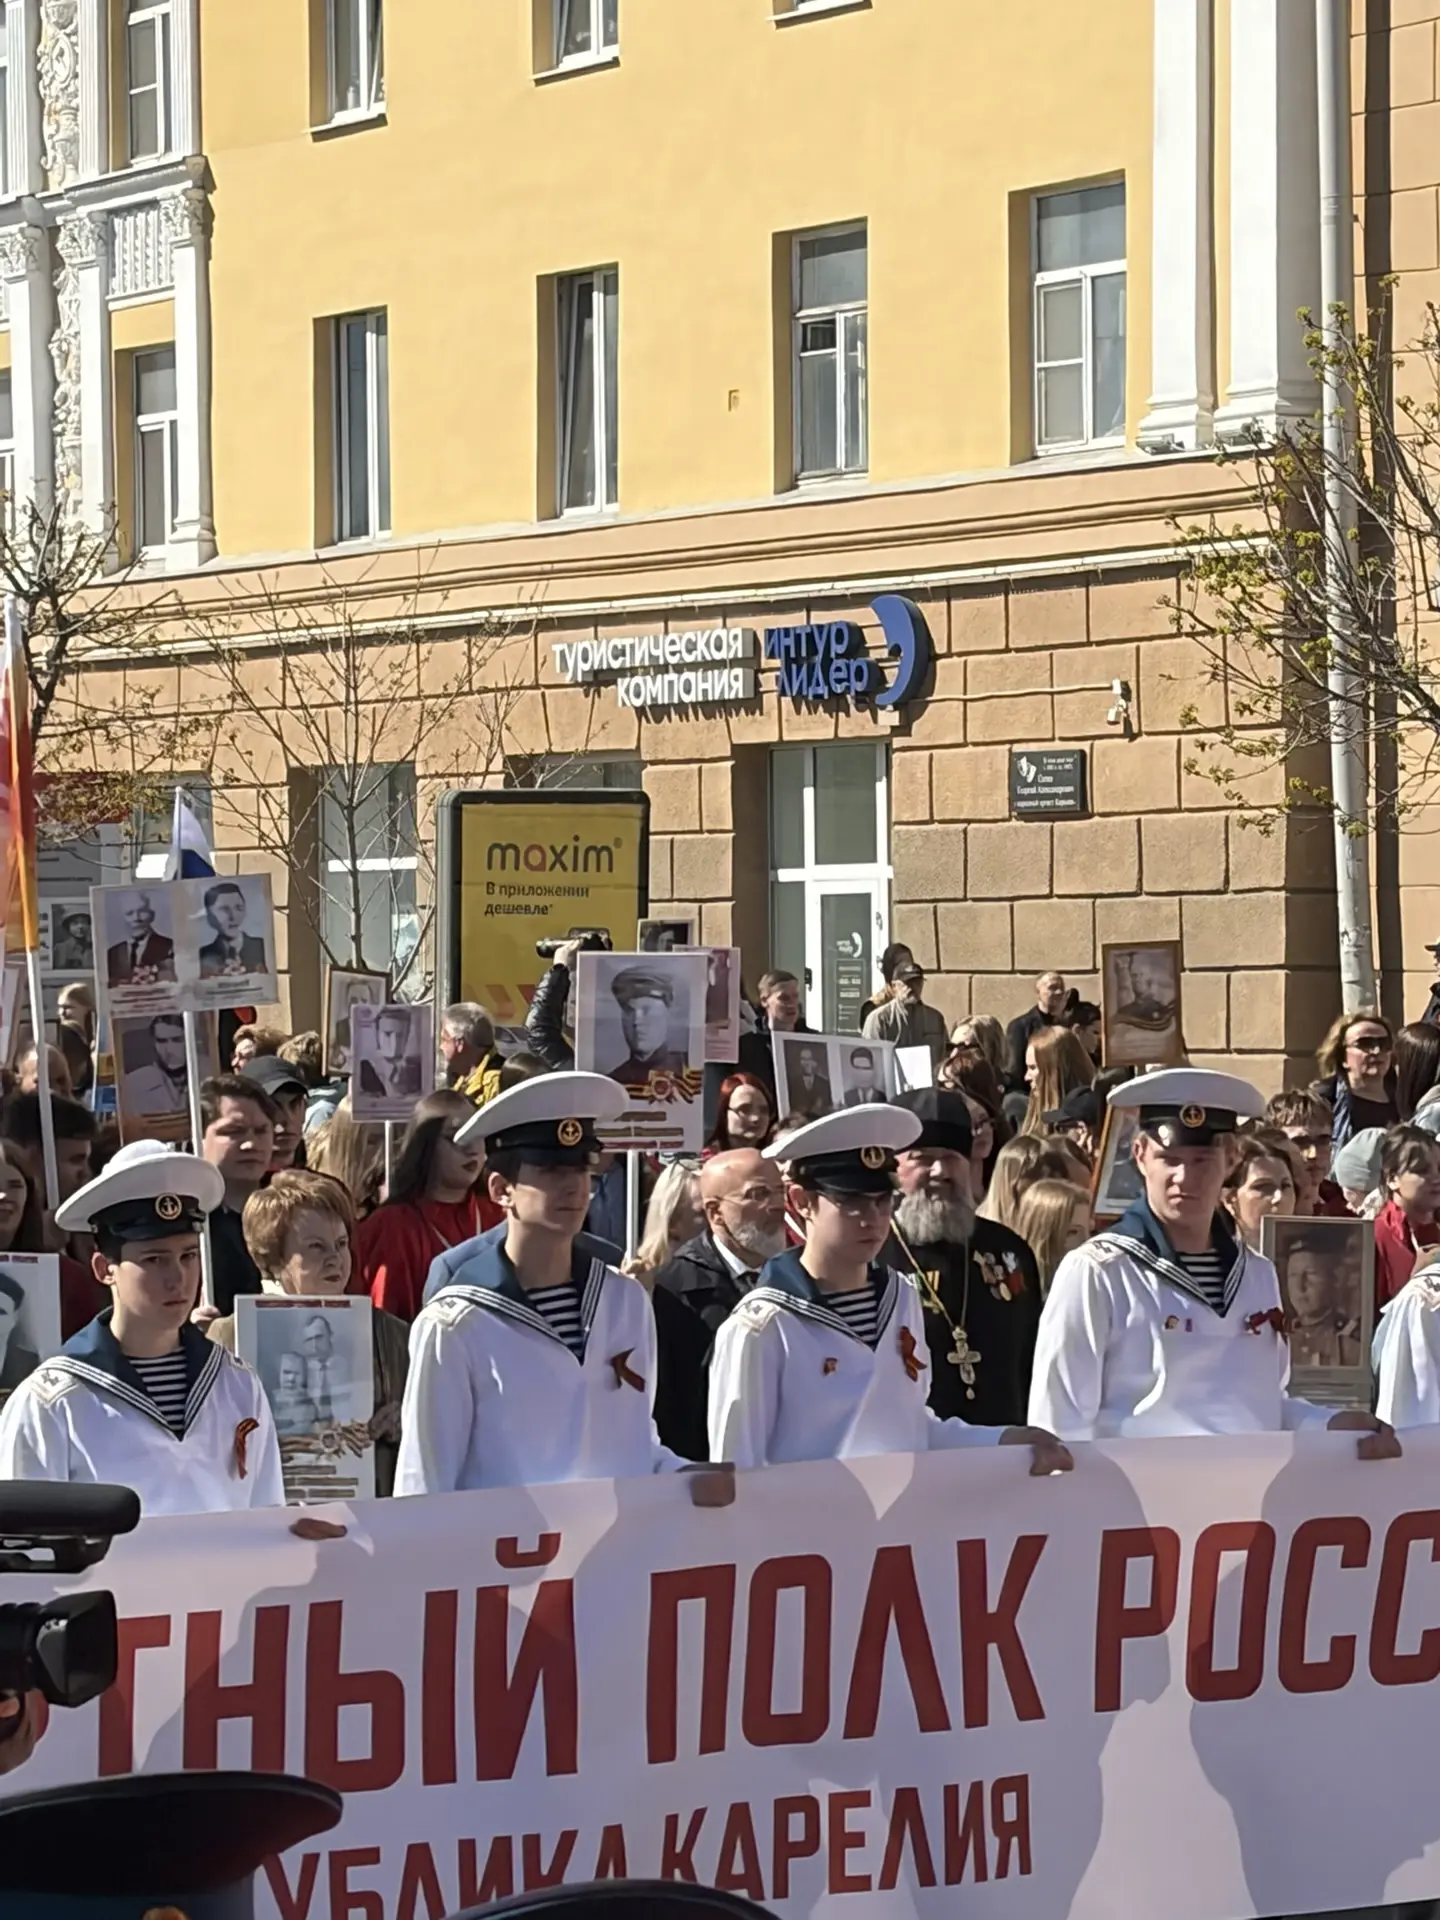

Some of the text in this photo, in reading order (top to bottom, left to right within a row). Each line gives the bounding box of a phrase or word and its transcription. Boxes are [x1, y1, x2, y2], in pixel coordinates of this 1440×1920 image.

[551, 627, 743, 682] туристическая
[764, 620, 849, 663] интур
[616, 667, 744, 708] компания
[777, 657, 869, 700] лидер
[487, 834, 614, 873] maxim
[486, 881, 590, 899] В приложении
[35, 1509, 1440, 1793] ТНЫЙ ПОЛК РОСС
[660, 1773, 1033, 1902] КАРЕЛИЯ
